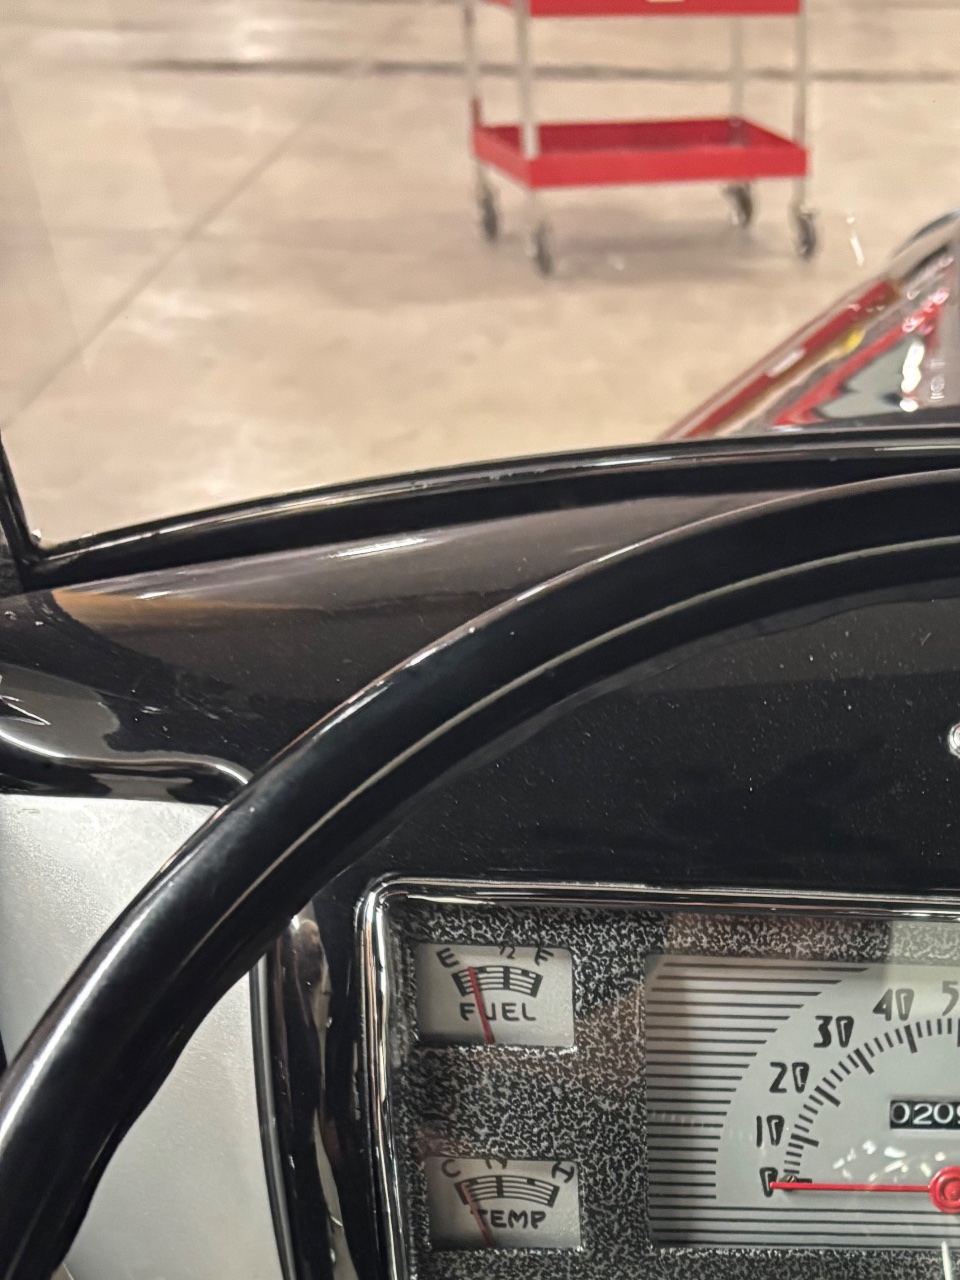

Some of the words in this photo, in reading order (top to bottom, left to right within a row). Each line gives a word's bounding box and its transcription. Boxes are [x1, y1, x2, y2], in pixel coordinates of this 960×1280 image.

[436, 947, 460, 968] E
[534, 947, 554, 966] F
[459, 1002, 537, 1021] FUEL
[872, 988, 914, 1021] 40
[813, 1015, 854, 1048] 30
[769, 1061, 810, 1094] 20
[756, 1115, 785, 1148] 10
[441, 1159, 462, 1178] C
[551, 1160, 575, 1184] H
[470, 1209, 547, 1230] TEMP
